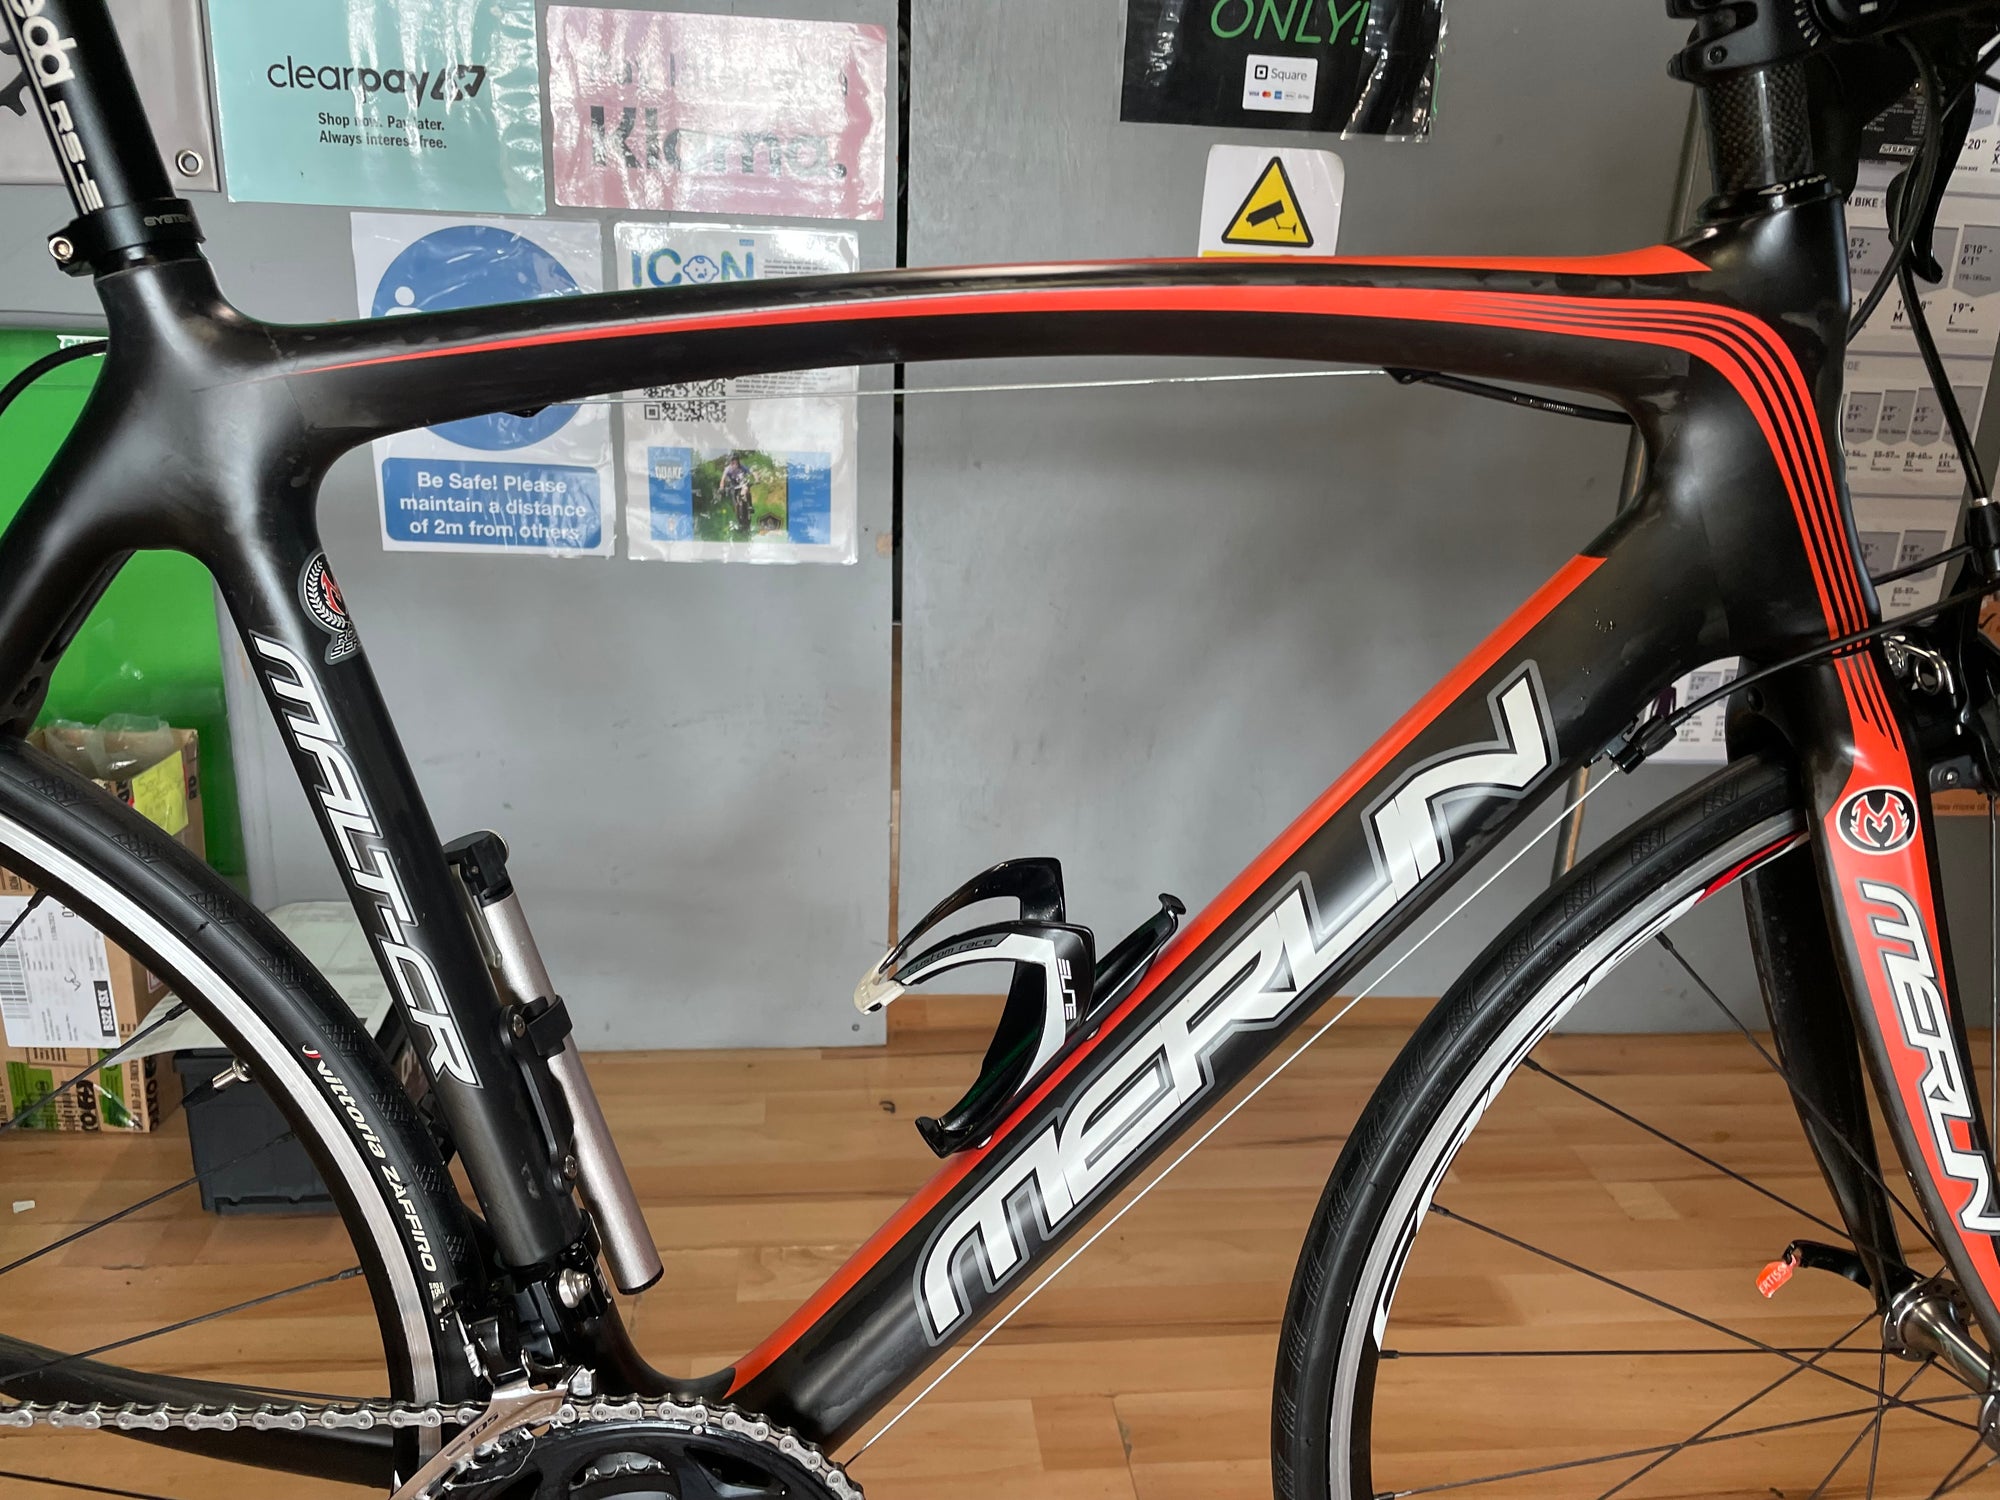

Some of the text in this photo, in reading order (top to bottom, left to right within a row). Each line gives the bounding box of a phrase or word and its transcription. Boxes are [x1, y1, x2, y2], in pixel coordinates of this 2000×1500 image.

[1211, 0, 1370, 46] ONLY!
[267, 55, 430, 107] clearpay
[1270, 67, 1308, 85] Square
[318, 112, 350, 128] Shop
[354, 116, 383, 128] now.
[387, 115, 406, 131] Pay
[319, 130, 362, 146] Always
[1854, 197, 1879, 208] BIKE
[416, 471, 567, 494] Be Safe! Please
[399, 496, 587, 518] maintain a distance
[409, 518, 429, 534] of
[434, 519, 464, 536] 2m
[468, 521, 513, 537] from
[957, 937, 994, 951] race
[919, 668, 1553, 1341] MERLIN
[1859, 880, 2000, 1235] MERLIN
[315, 1058, 437, 1273] vittoria ZAFFIRO
